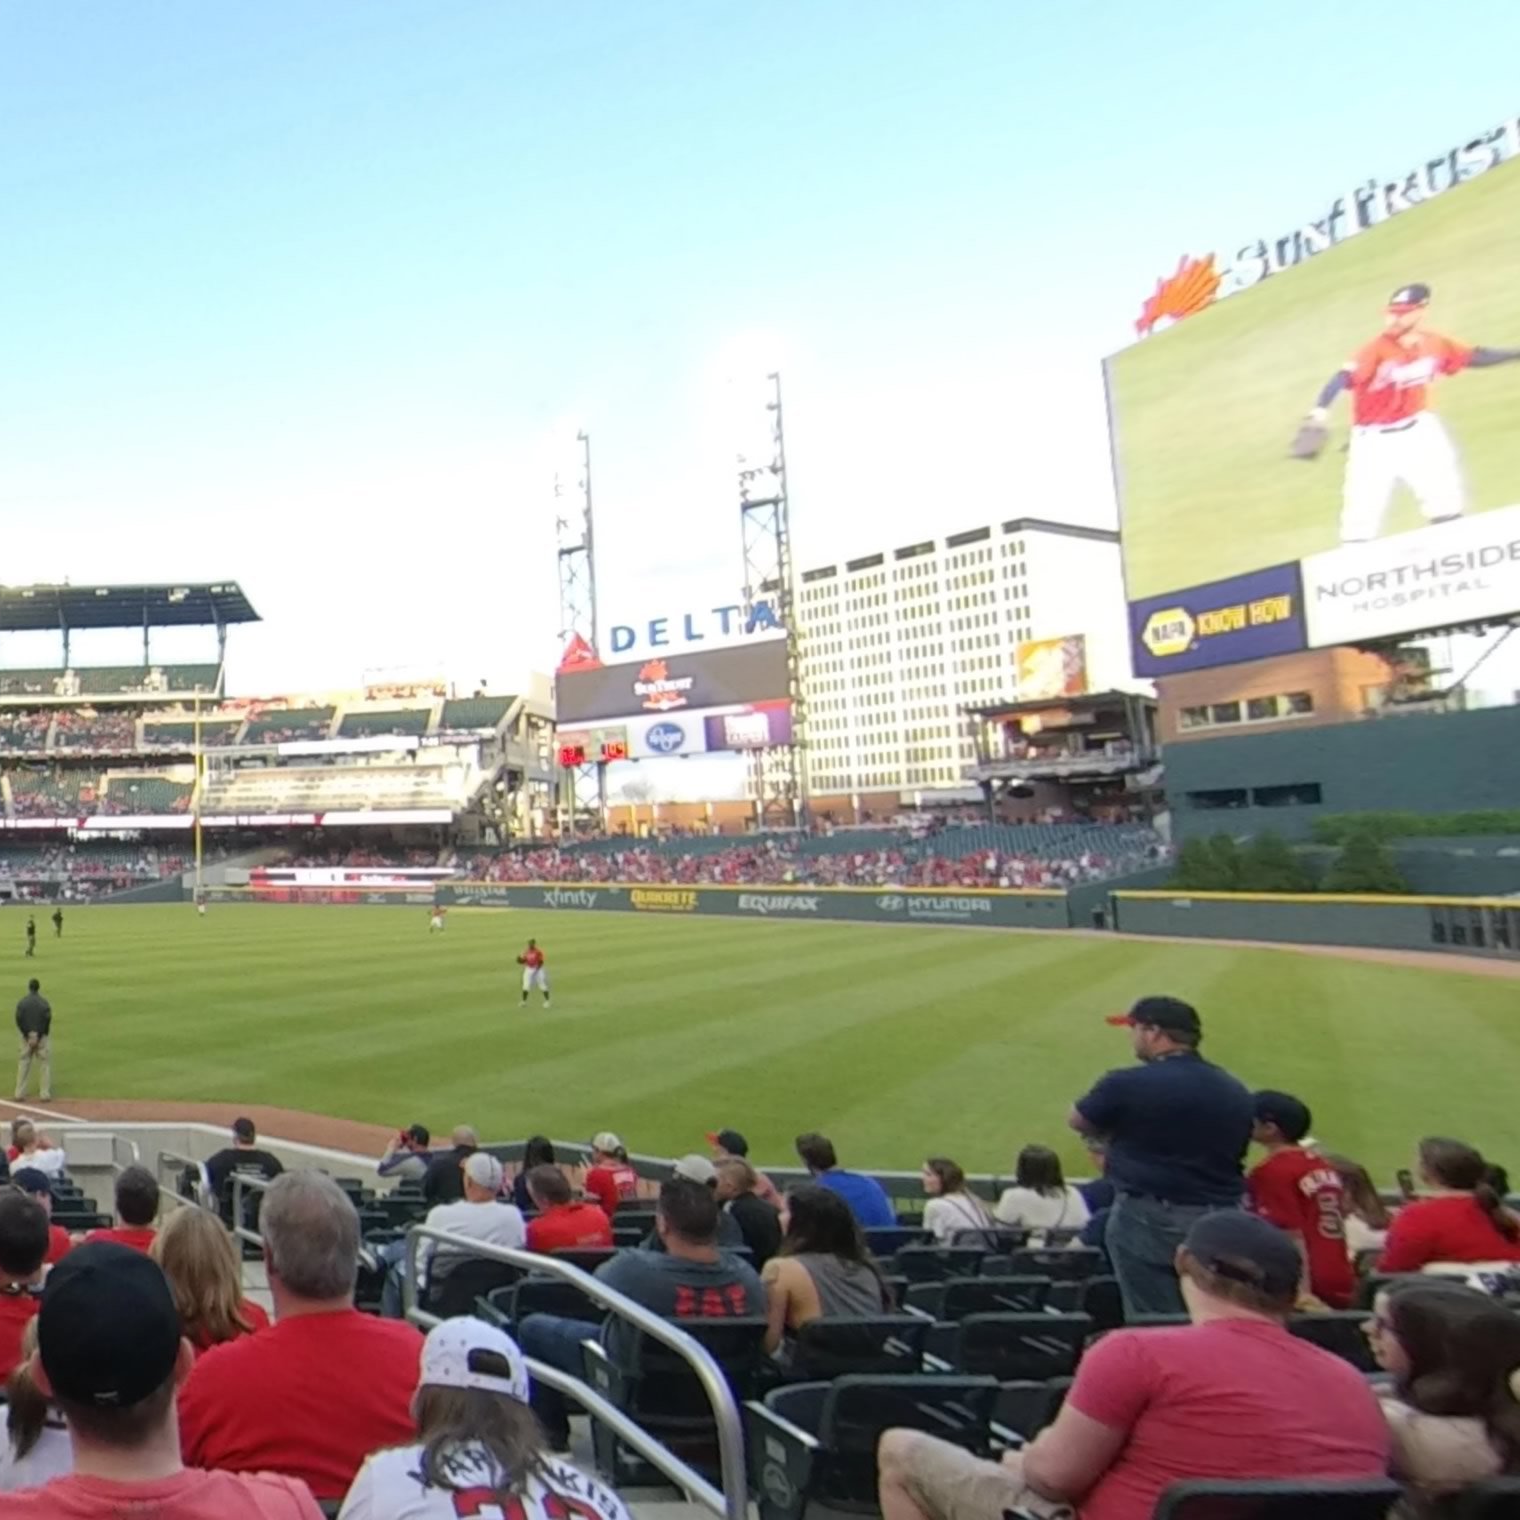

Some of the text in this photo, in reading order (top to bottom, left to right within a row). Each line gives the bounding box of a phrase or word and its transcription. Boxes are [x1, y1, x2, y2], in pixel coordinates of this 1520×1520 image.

[1352, 577, 1490, 613] HOSPITAL
[611, 600, 779, 652] DELTA
[1197, 595, 1291, 636] KNOW HOW
[1152, 621, 1186, 643] NAPA
[544, 887, 597, 908] xfinity
[738, 894, 819, 913] EQUIFAX
[907, 897, 992, 912] HYUNDAI
